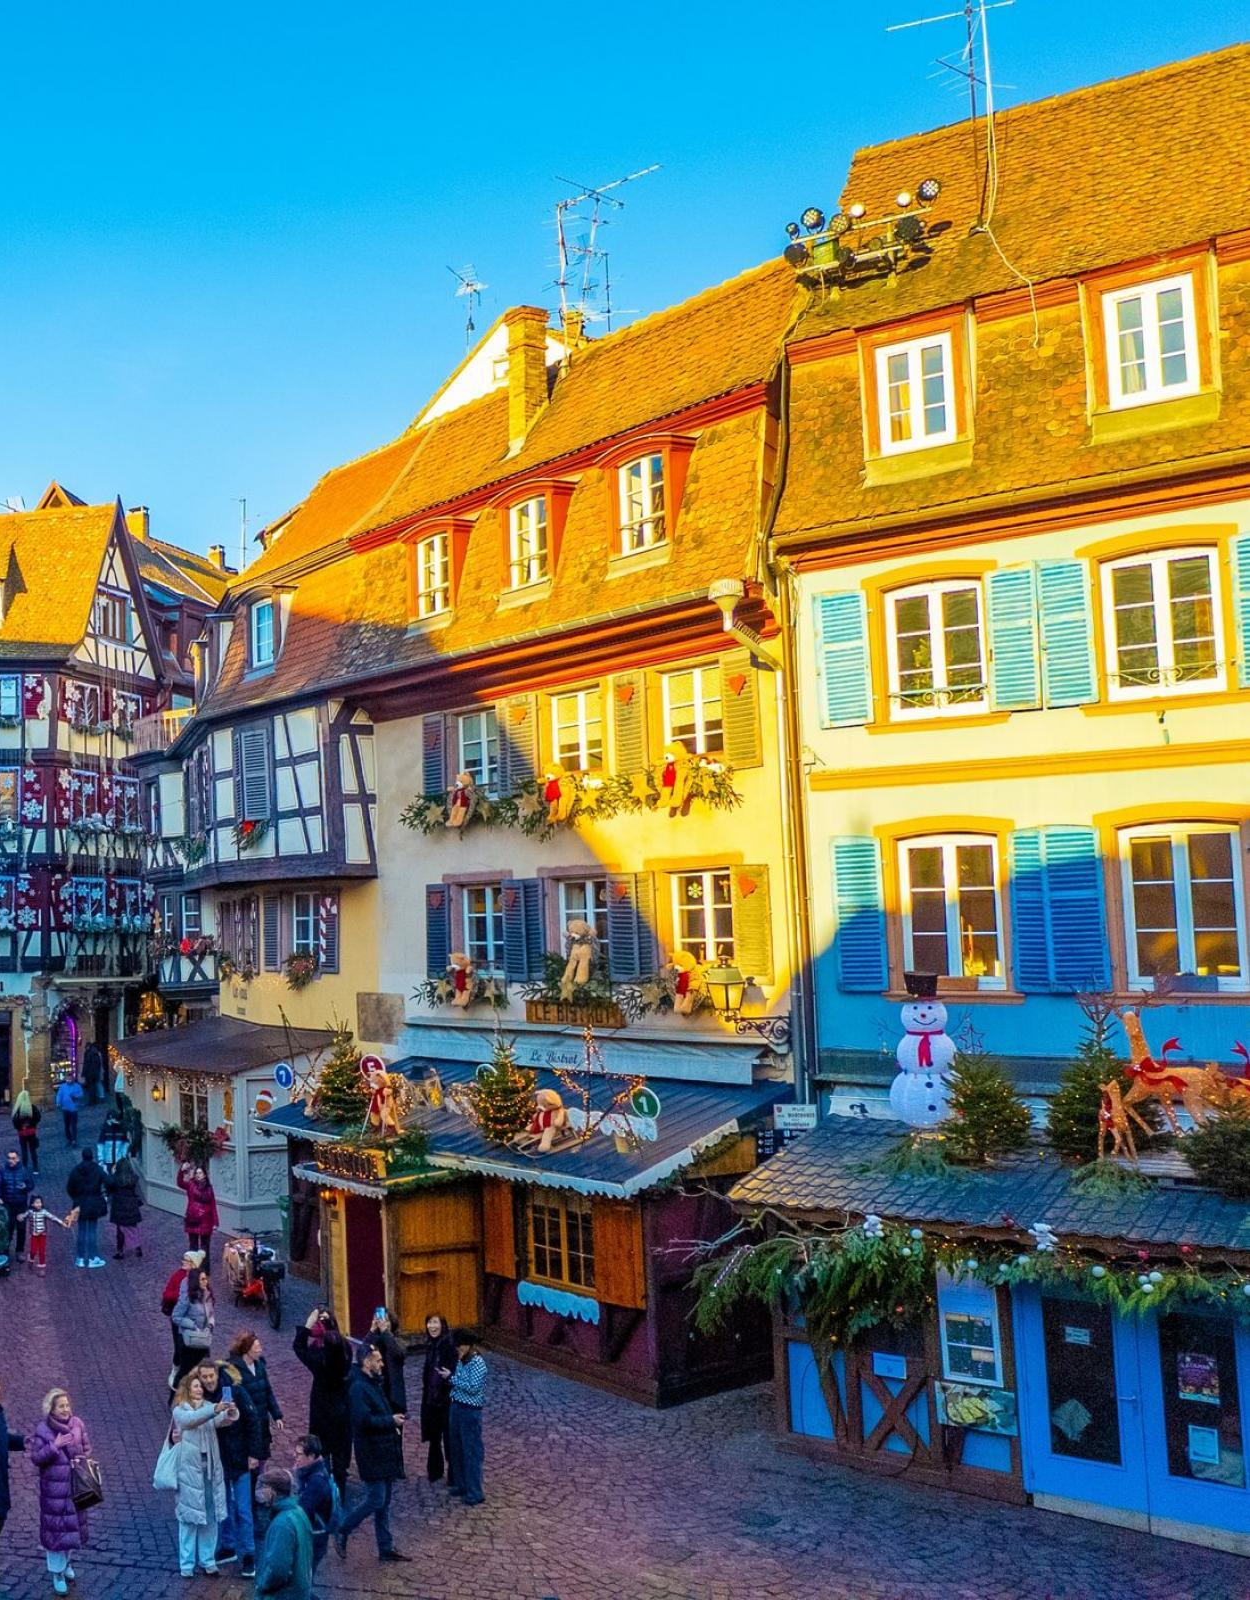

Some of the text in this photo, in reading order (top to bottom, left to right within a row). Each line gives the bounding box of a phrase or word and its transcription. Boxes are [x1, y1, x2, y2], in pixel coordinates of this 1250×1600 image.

[534, 1002, 552, 1021] LE
[530, 1049, 579, 1065] Le Bistrot
[638, 1095, 649, 1113] 1
